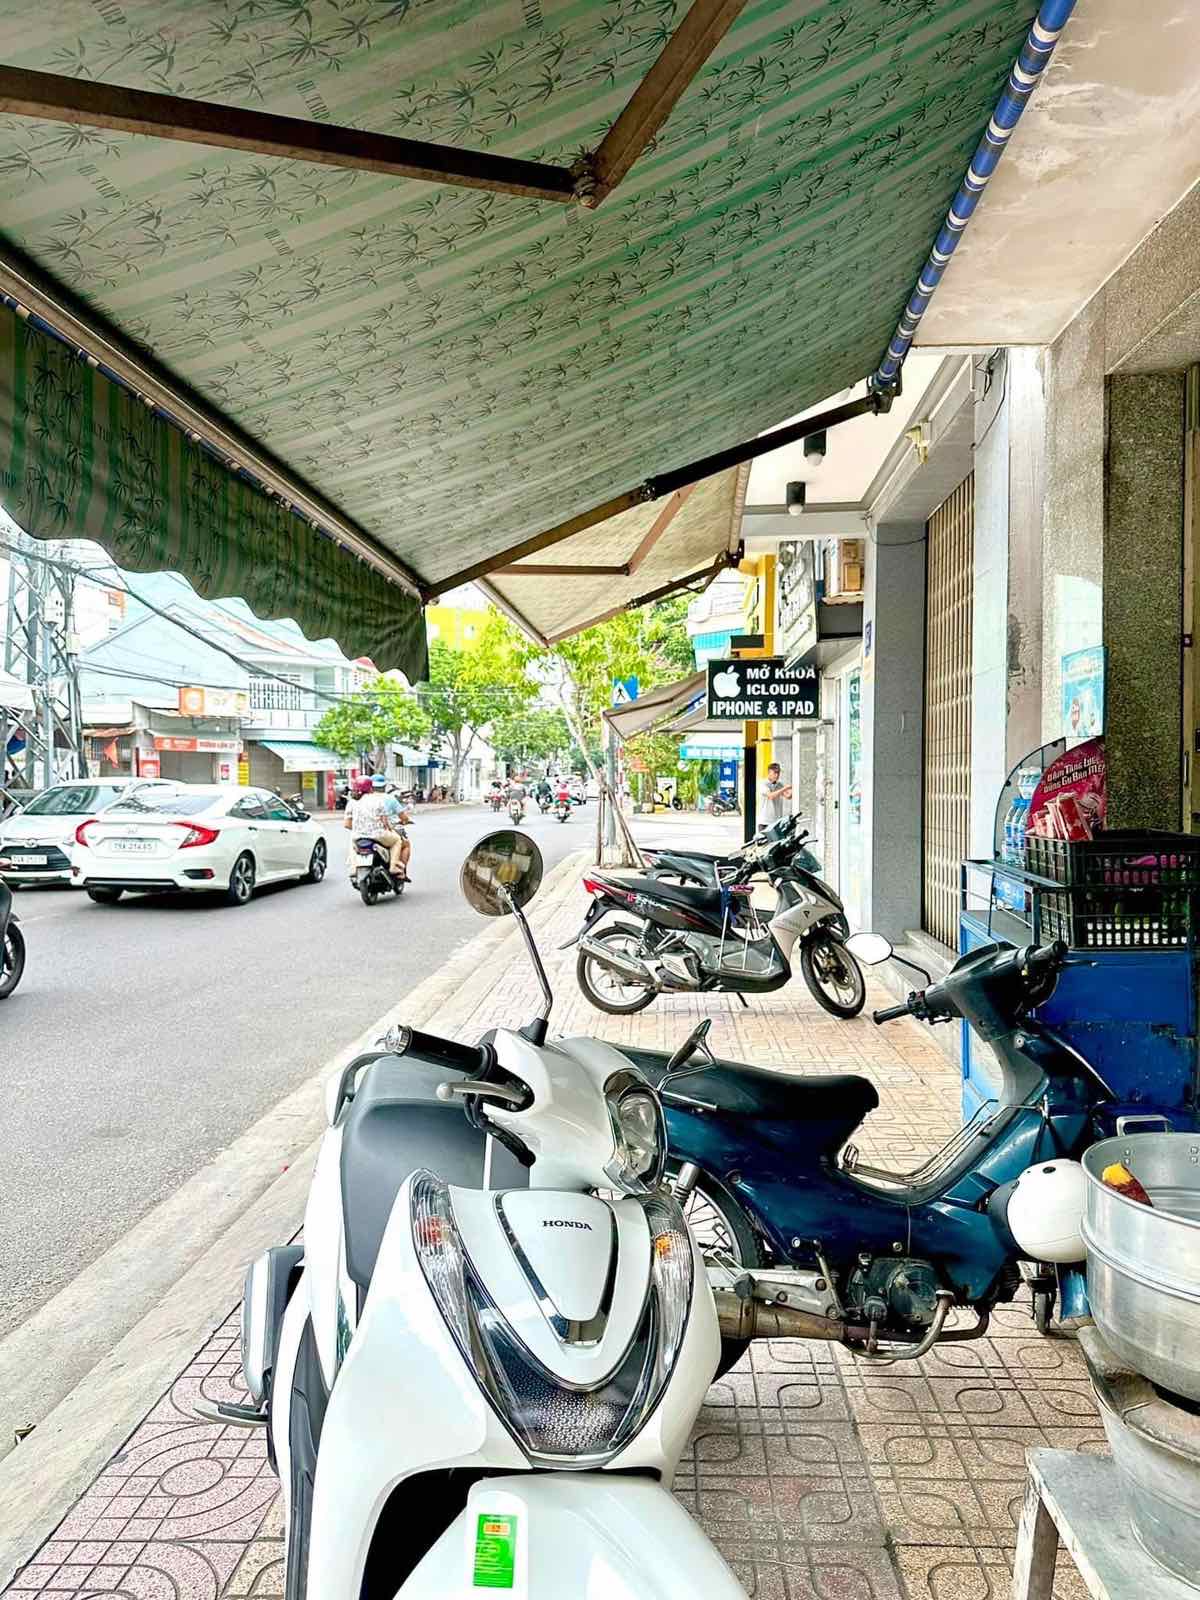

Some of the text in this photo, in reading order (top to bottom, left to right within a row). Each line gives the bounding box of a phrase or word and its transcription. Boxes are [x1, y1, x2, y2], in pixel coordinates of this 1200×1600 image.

[746, 664, 771, 679] MỞ
[746, 684, 800, 695] ICLOUD
[712, 701, 814, 716] IPHONE & IPAD
[543, 1219, 593, 1231] HONDA
